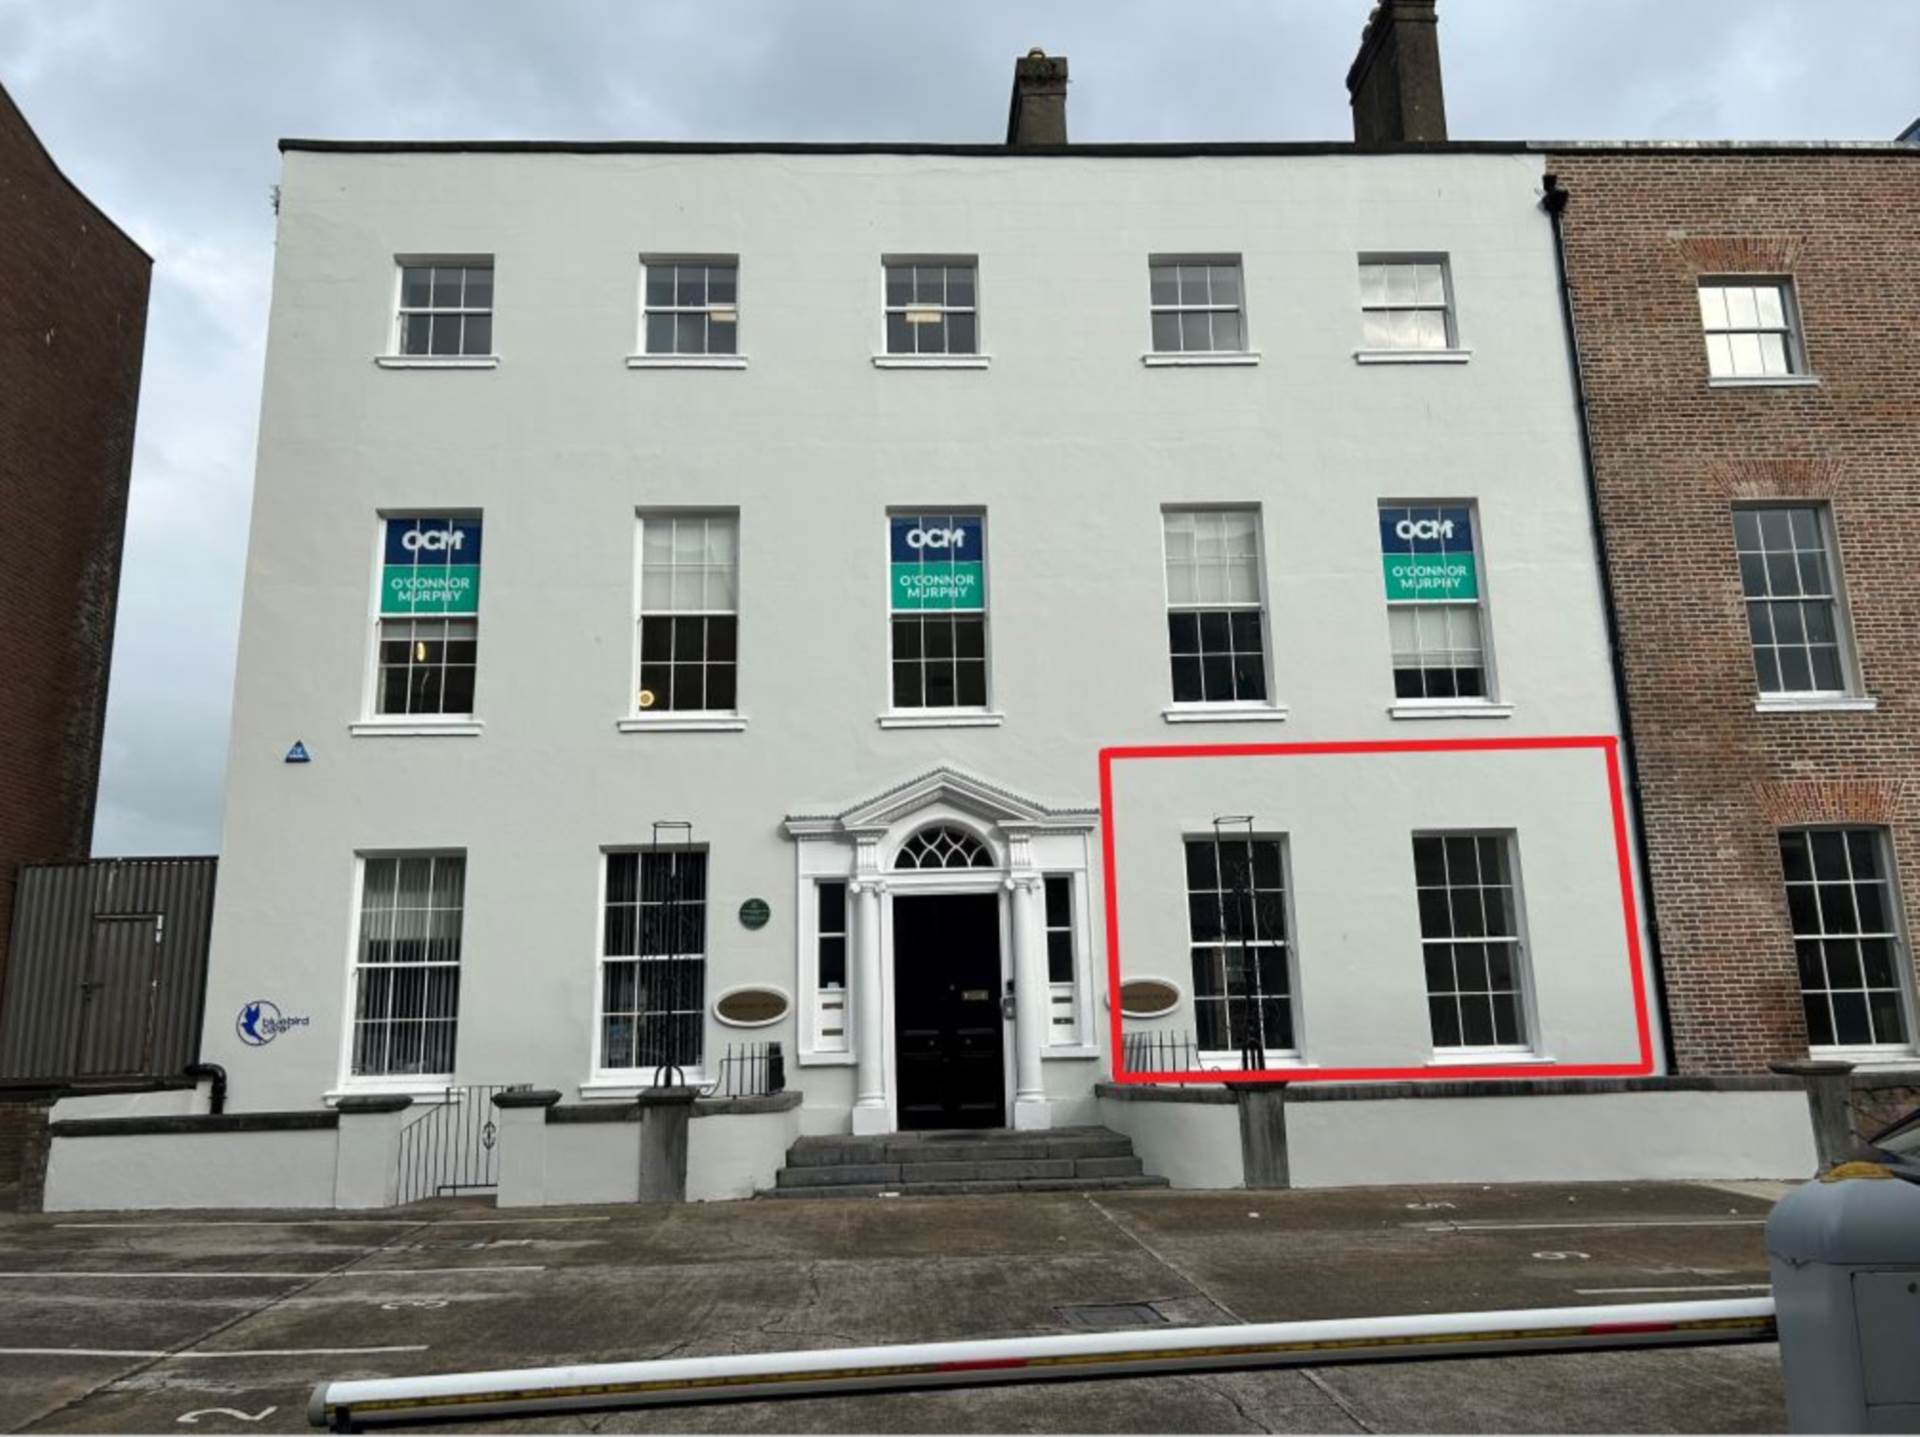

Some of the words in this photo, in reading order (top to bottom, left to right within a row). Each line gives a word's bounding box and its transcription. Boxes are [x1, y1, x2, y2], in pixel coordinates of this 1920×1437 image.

[1395, 519, 1455, 539] OCM
[401, 530, 465, 550] OCM
[906, 528, 966, 548] OCM
[1391, 565, 1467, 577] O'CONNOR
[390, 577, 470, 590] O'CONNOR
[899, 574, 975, 586] O'CONNOR
[1400, 578, 1461, 590] MURPHY
[397, 590, 462, 602] MURPHY
[906, 586, 968, 598] MURPHY
